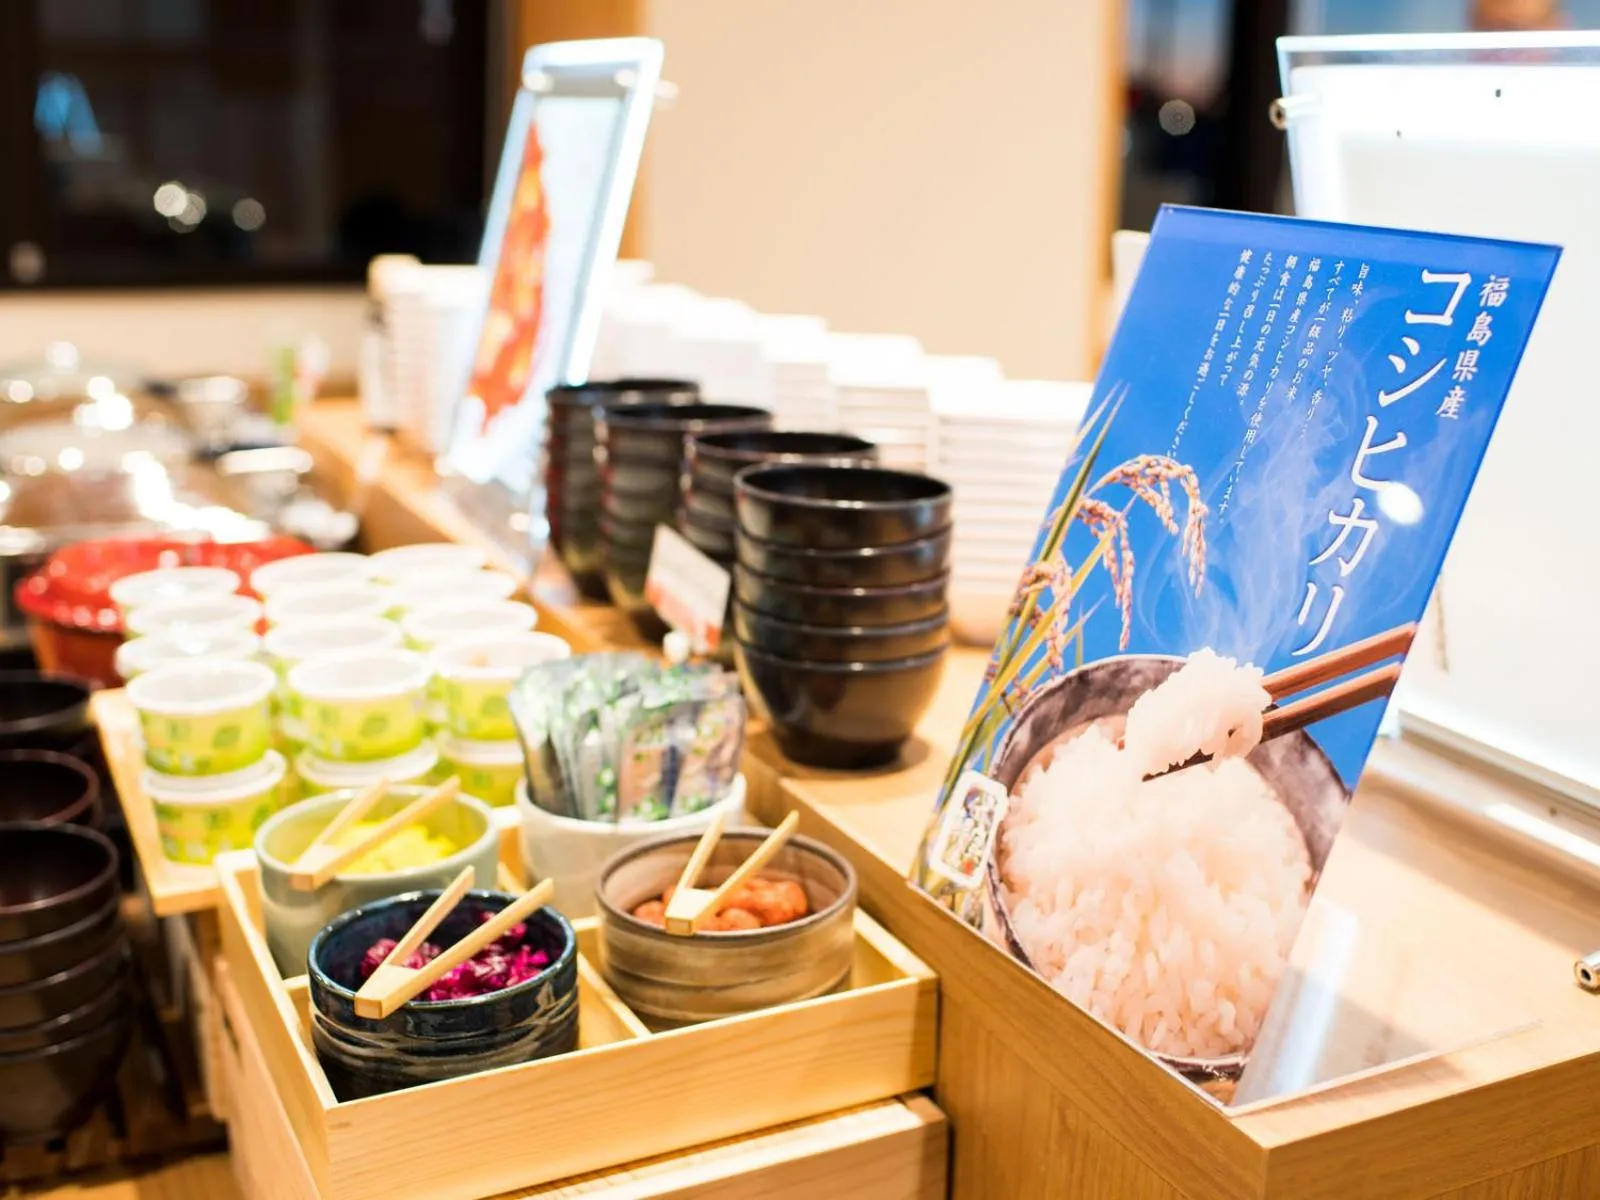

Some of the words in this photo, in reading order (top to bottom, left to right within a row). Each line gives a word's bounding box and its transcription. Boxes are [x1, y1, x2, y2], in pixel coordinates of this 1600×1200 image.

[1286, 260, 1345, 401] すべてが一級品のお米
[1434, 274, 1511, 420] 福島県産
[1291, 268, 1472, 656] コシヒカリ
